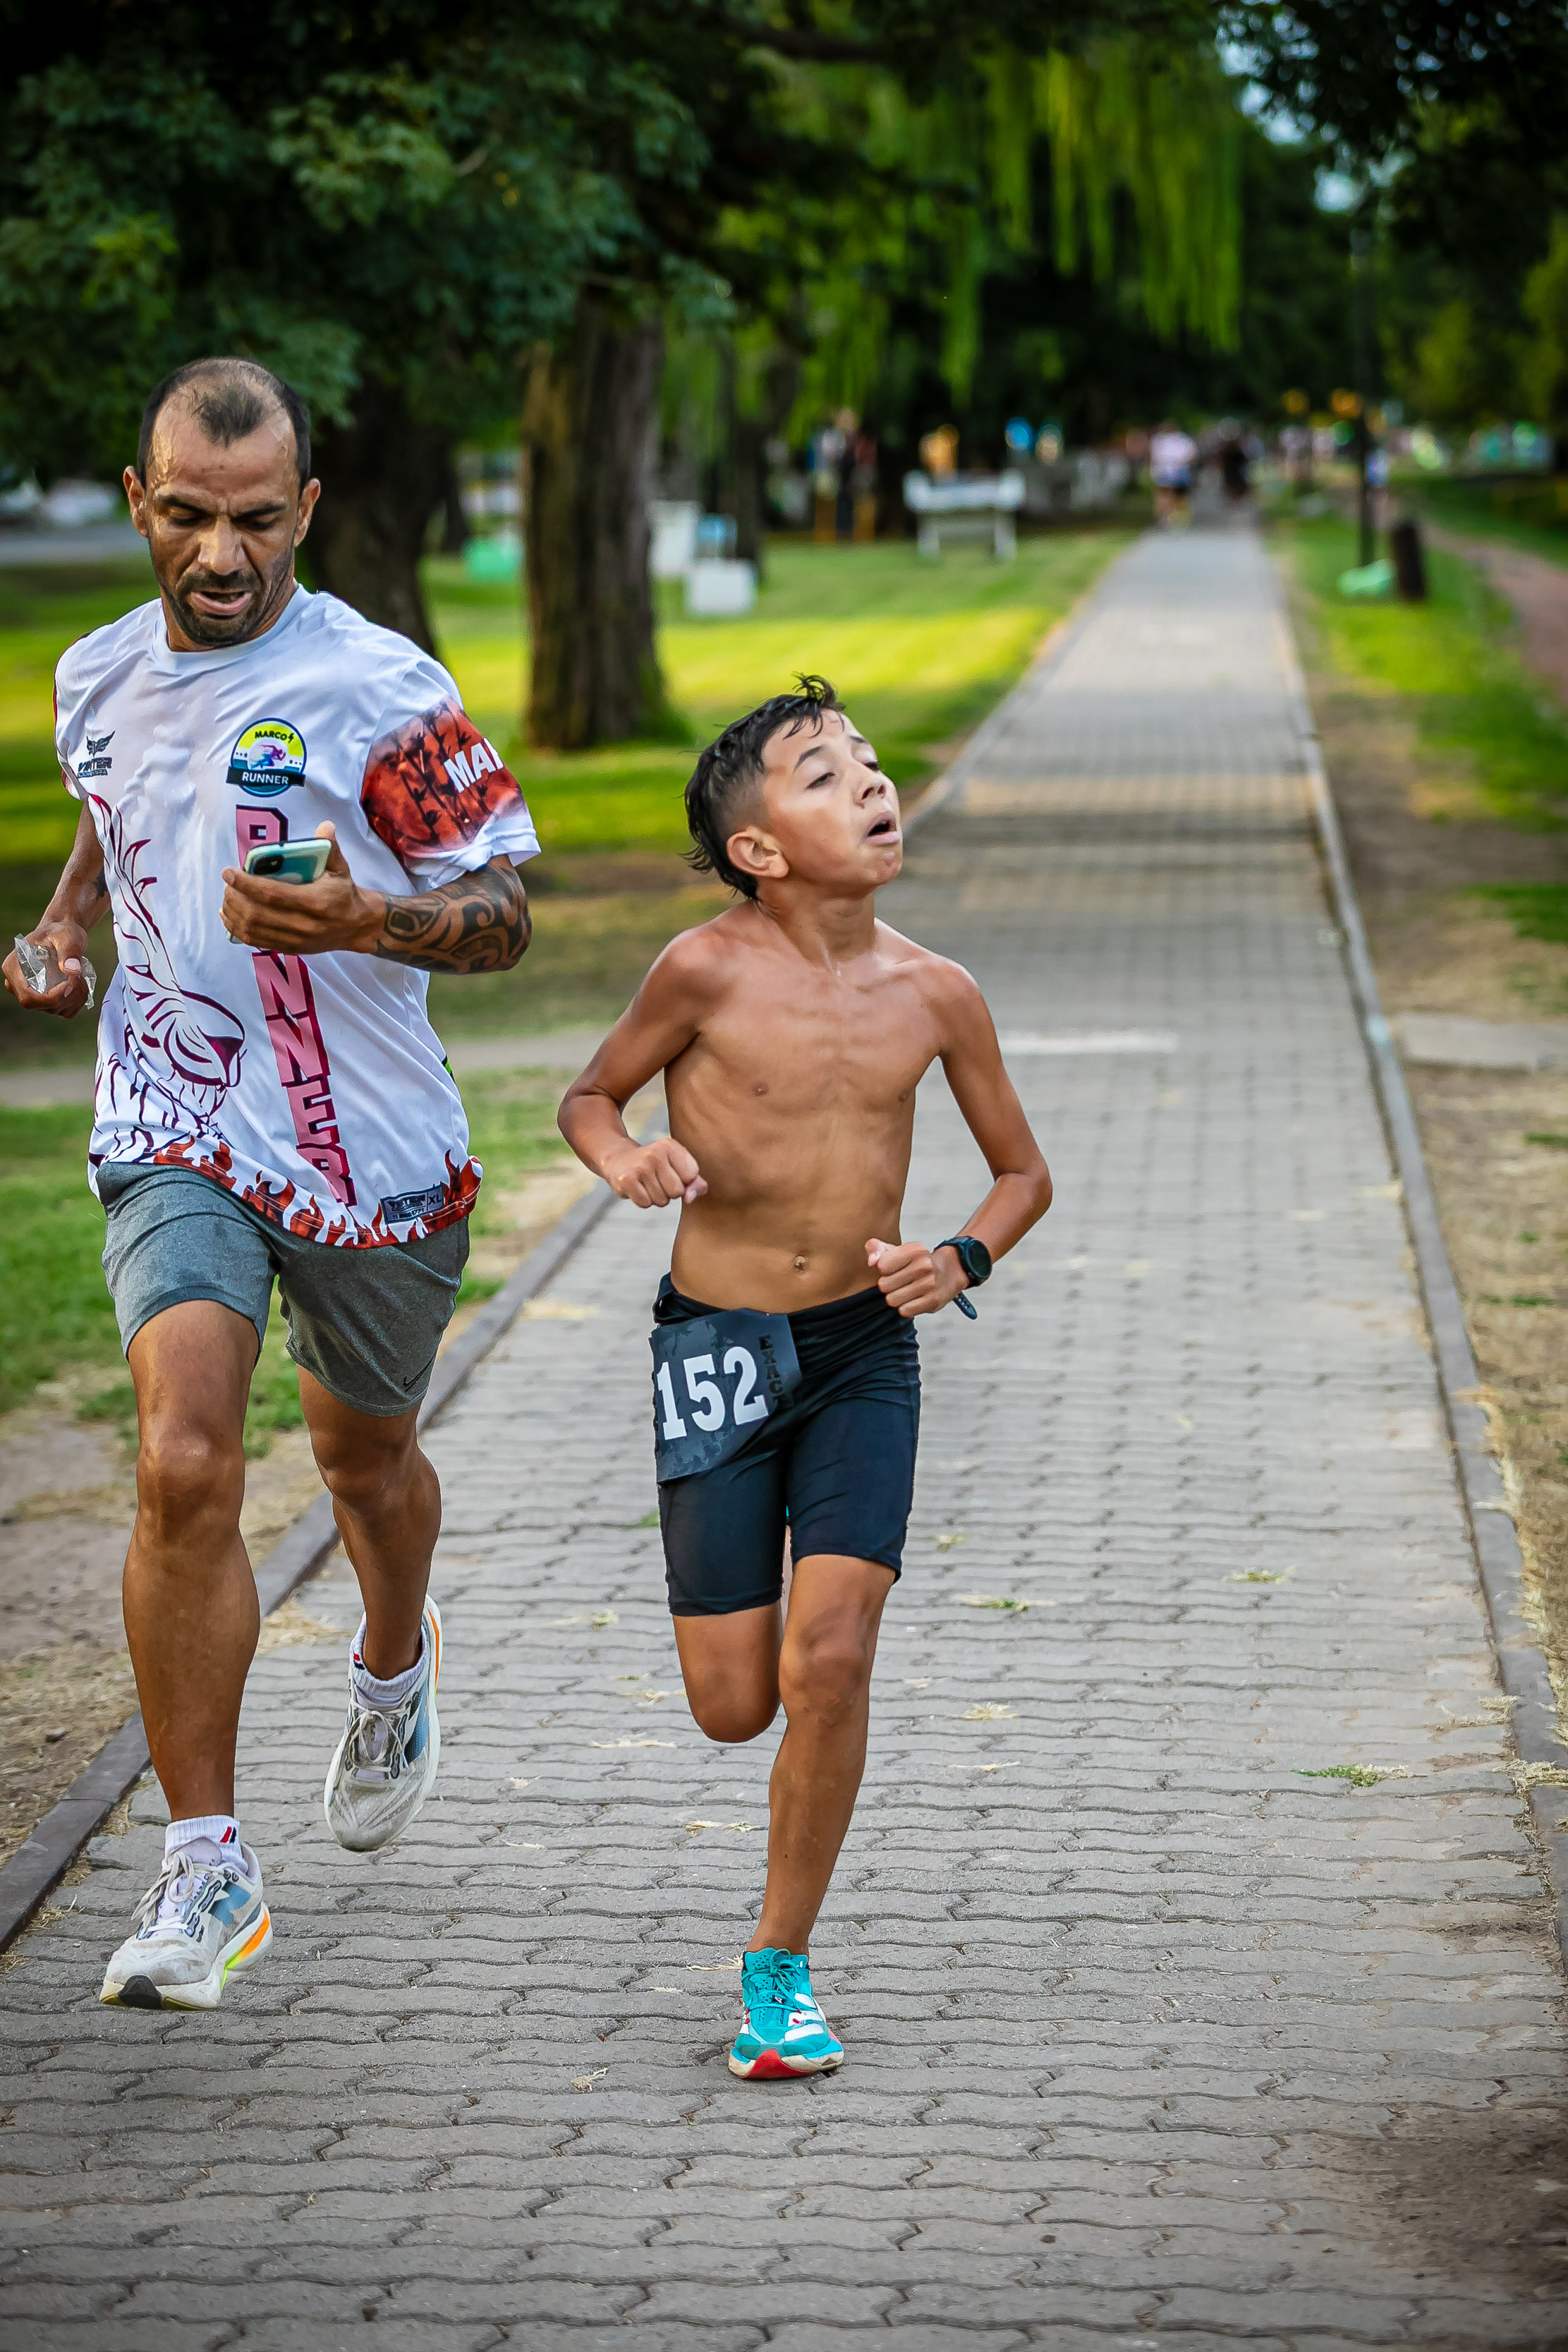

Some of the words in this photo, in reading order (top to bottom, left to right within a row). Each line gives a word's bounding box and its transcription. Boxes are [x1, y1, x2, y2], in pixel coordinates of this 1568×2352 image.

[255, 730, 288, 741] MARCO
[242, 772, 288, 784] RUNNER
[236, 804, 358, 1207] RNNER
[427, 1194, 442, 1206] XL
[657, 1346, 769, 1440] 152
